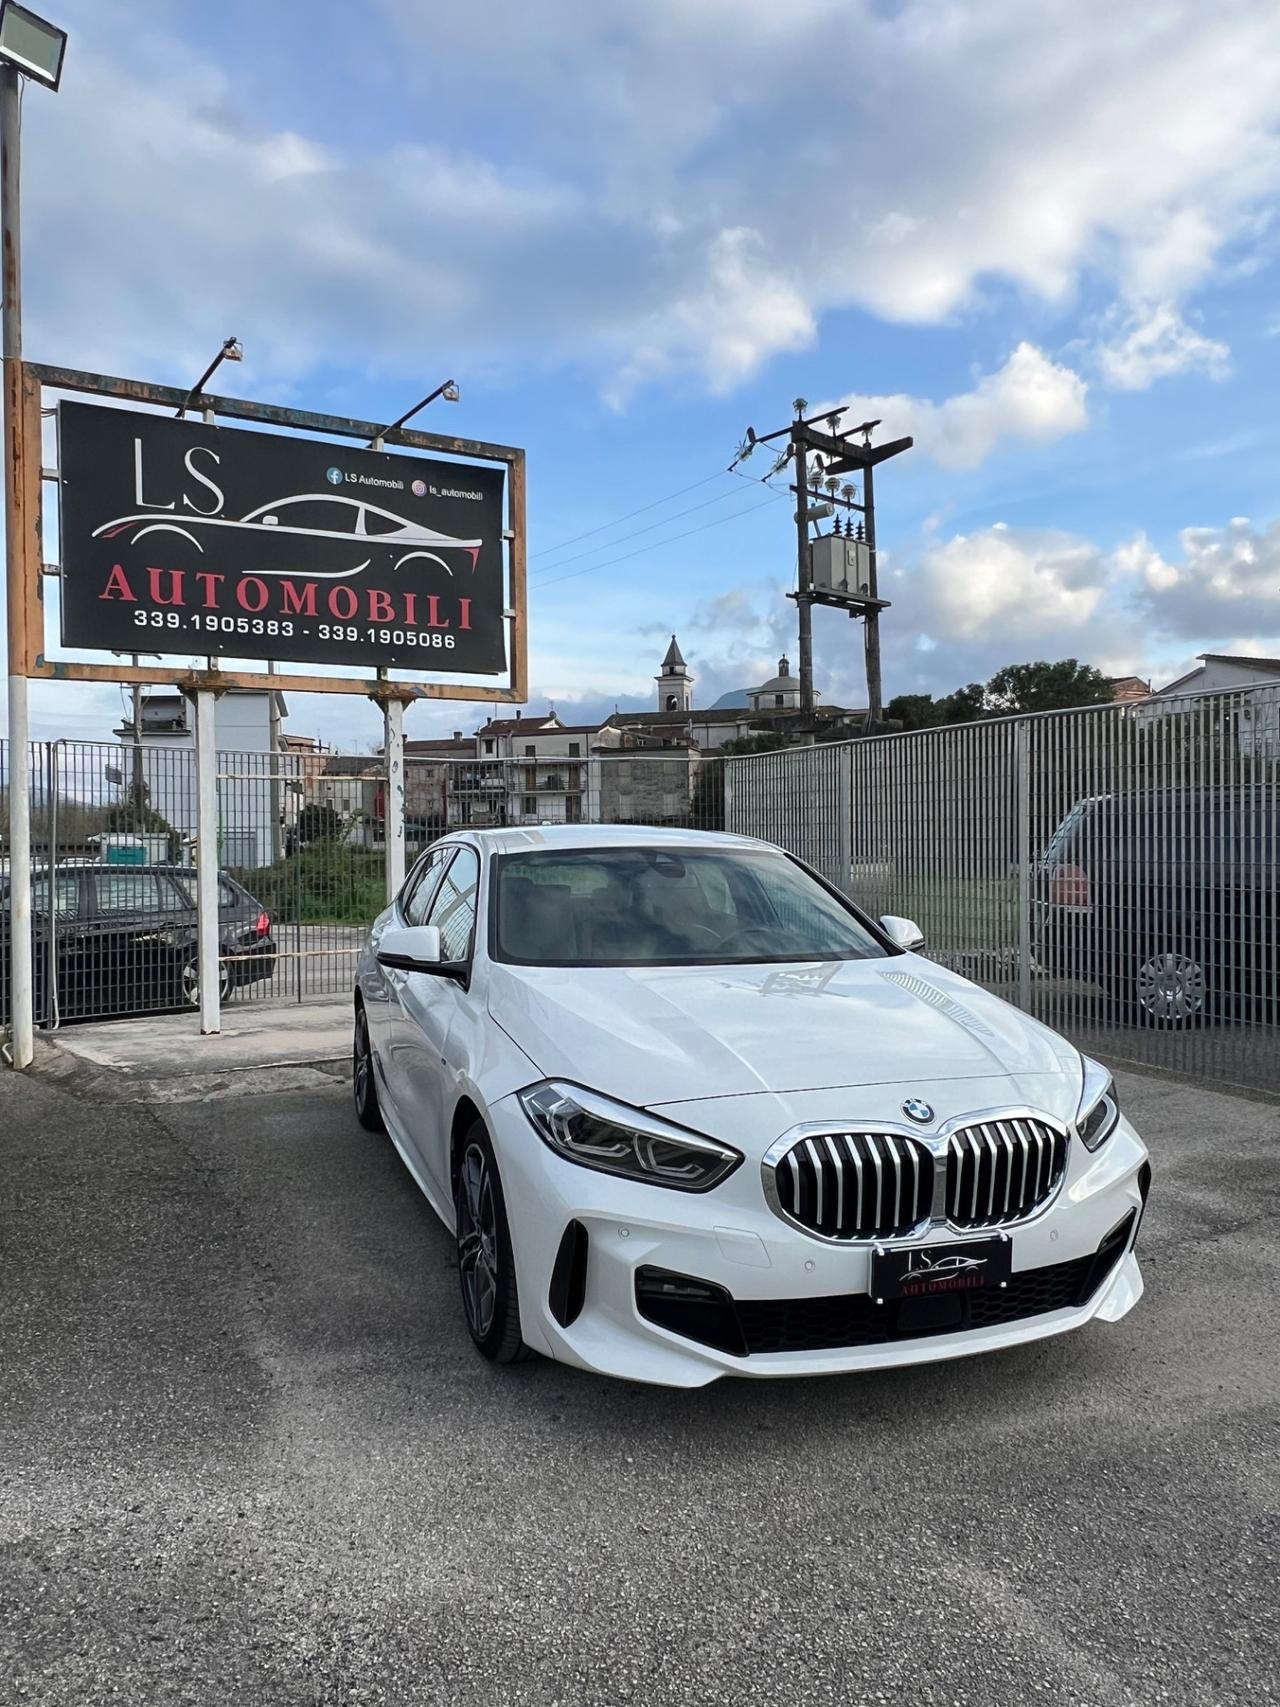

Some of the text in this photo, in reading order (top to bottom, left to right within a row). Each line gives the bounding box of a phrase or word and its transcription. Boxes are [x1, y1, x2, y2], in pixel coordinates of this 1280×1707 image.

[135, 438, 225, 515] LS
[345, 472, 358, 483] LS
[359, 475, 404, 489] Automobili
[429, 485, 483, 501] ls_automobili
[99, 564, 473, 629] AUTOMOBILI
[134, 610, 294, 636] 339.1905383
[318, 624, 456, 649] 339.1905086
